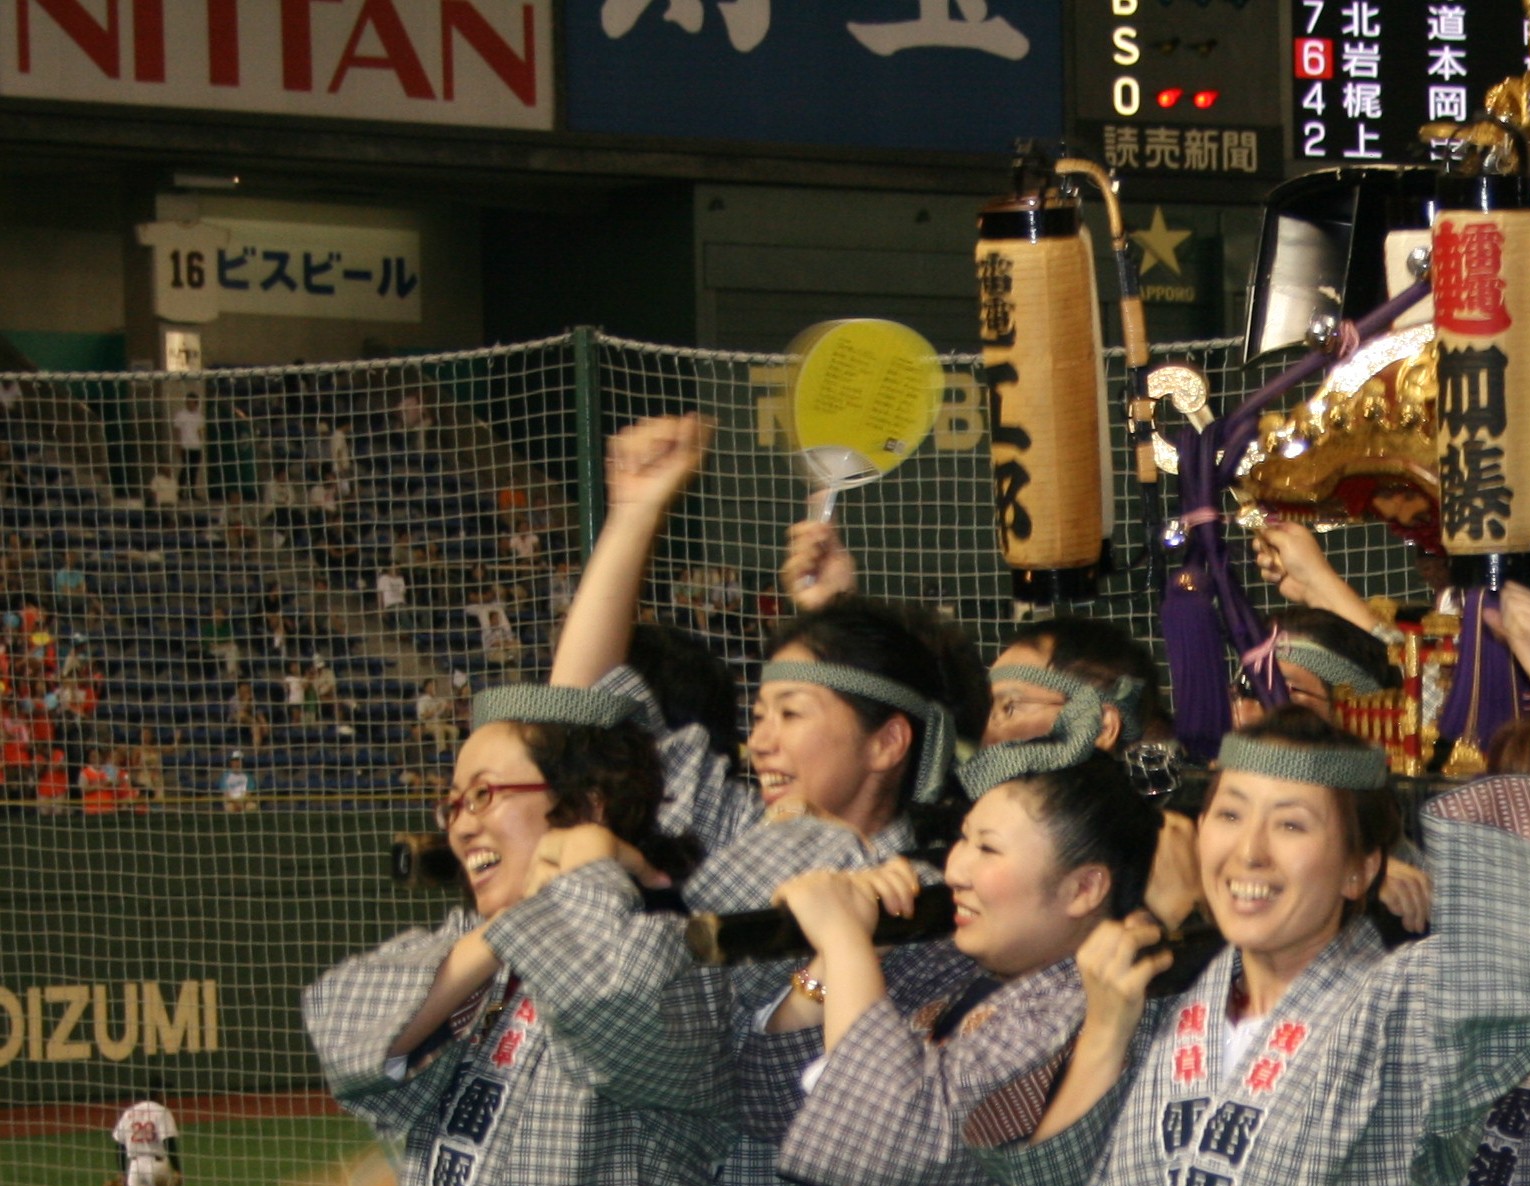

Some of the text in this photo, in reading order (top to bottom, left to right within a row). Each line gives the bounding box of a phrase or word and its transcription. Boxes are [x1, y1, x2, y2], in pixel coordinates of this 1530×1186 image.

[1303, 0, 1467, 40] 7 北 道
[1113, 26, 1140, 65] S
[1303, 40, 1467, 81] 6 岩 本
[1302, 82, 1326, 117] 4
[1428, 86, 1467, 121] 岡
[1103, 126, 1258, 172] 読売新聞
[1303, 122, 1383, 159] 2 上
[169, 249, 205, 289] 16
